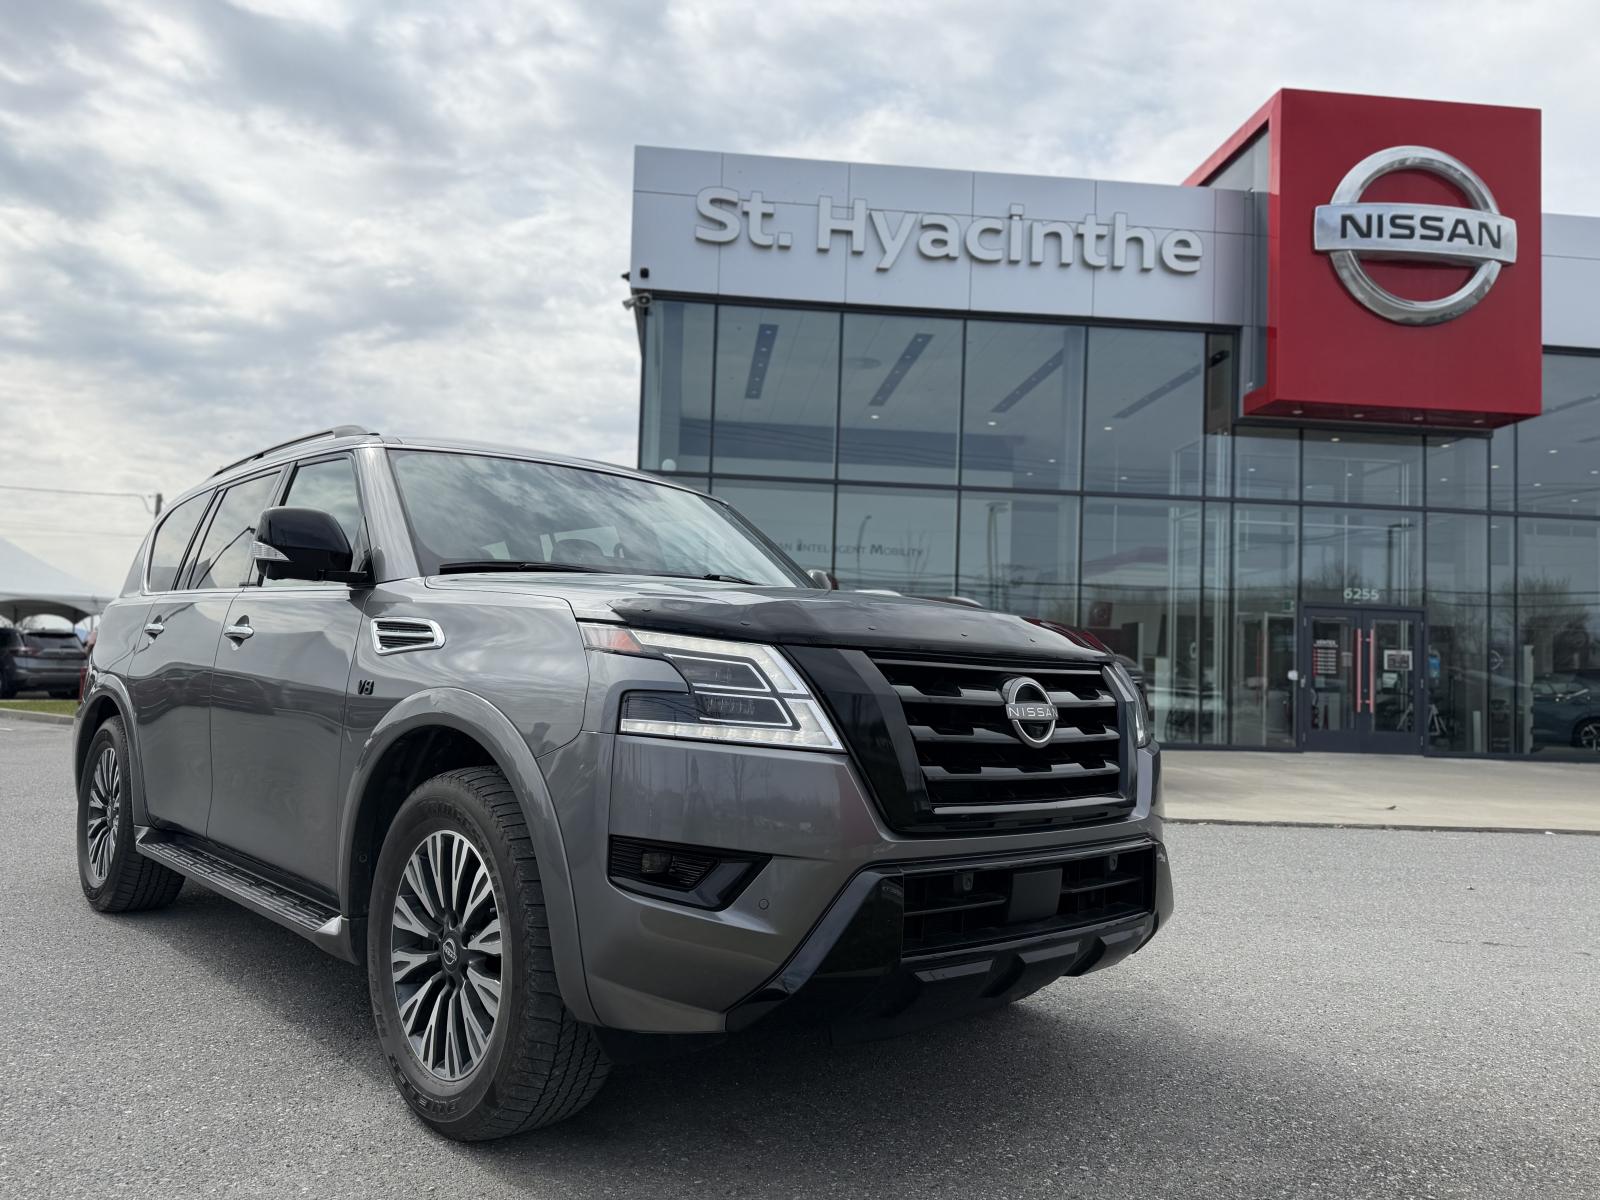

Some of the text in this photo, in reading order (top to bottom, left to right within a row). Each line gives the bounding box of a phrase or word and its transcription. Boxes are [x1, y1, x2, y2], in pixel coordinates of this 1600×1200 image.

[695, 186, 1203, 274] St. Hyacinthe
[1340, 213, 1501, 249] NISSAN
[1343, 587, 1379, 601] 6255
[358, 679, 375, 695] V8
[1008, 706, 1058, 718] NISSAN
